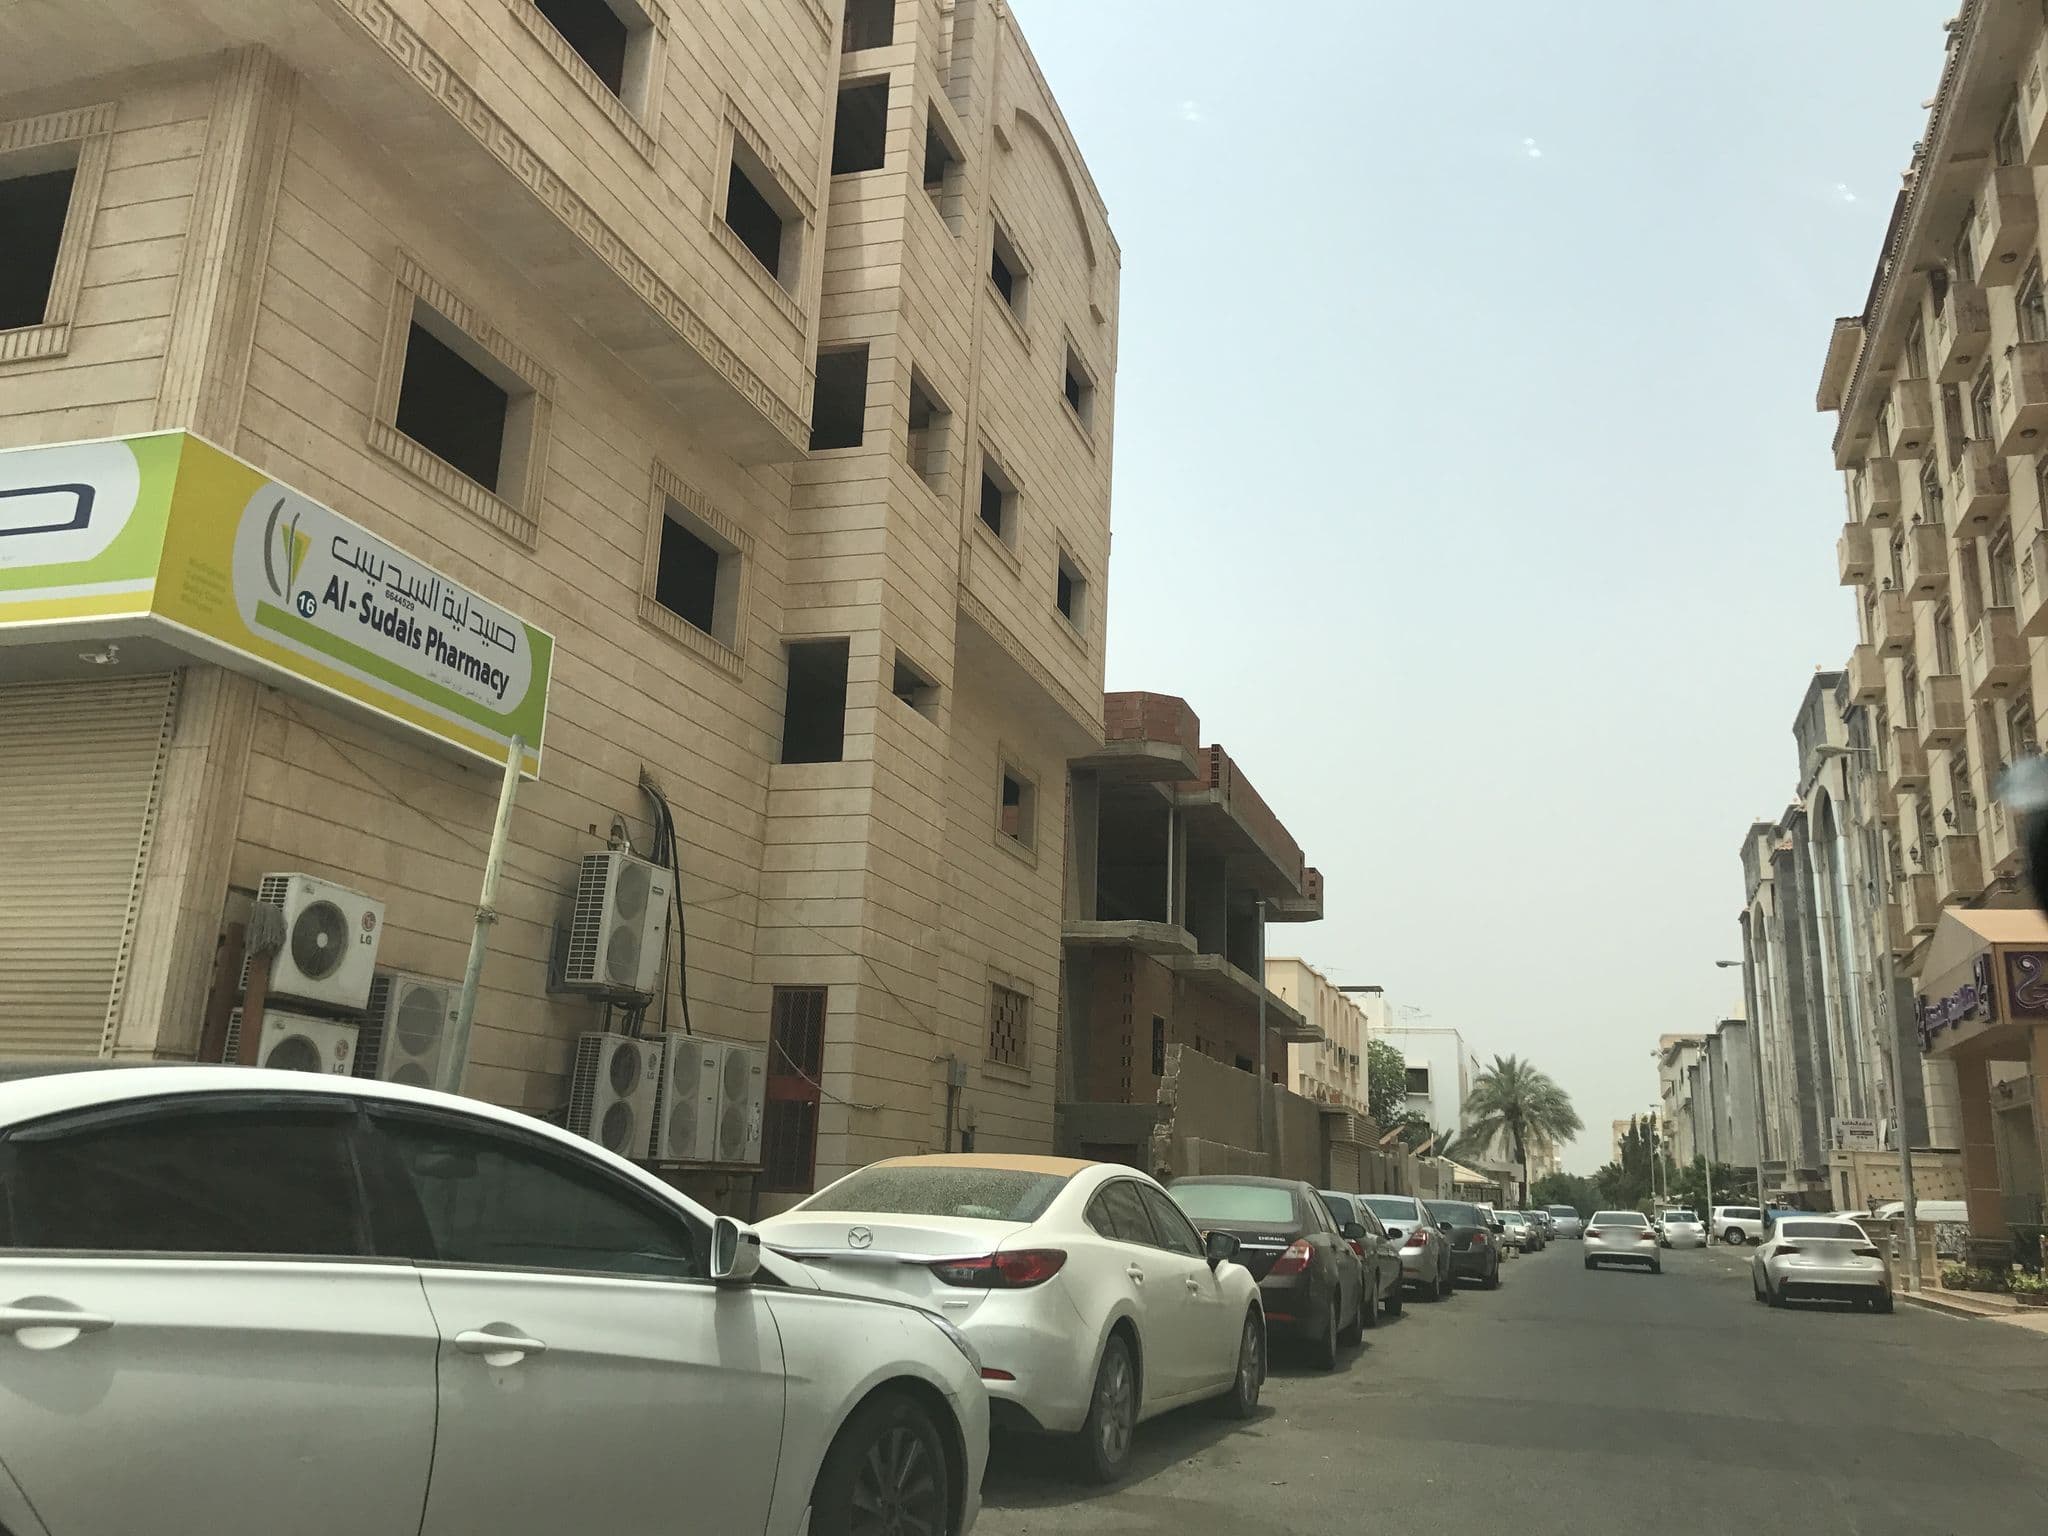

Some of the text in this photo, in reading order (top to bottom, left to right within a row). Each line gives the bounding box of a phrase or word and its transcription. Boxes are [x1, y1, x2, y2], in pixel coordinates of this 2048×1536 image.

[299, 594, 315, 615] 16
[332, 535, 516, 654] صيدلية السديس
[384, 589, 415, 612] 6644529
[322, 574, 422, 650] Al-Sudais
[424, 625, 510, 700] Pharmacy
[360, 933, 372, 945] LG
[332, 1063, 345, 1074] LG
